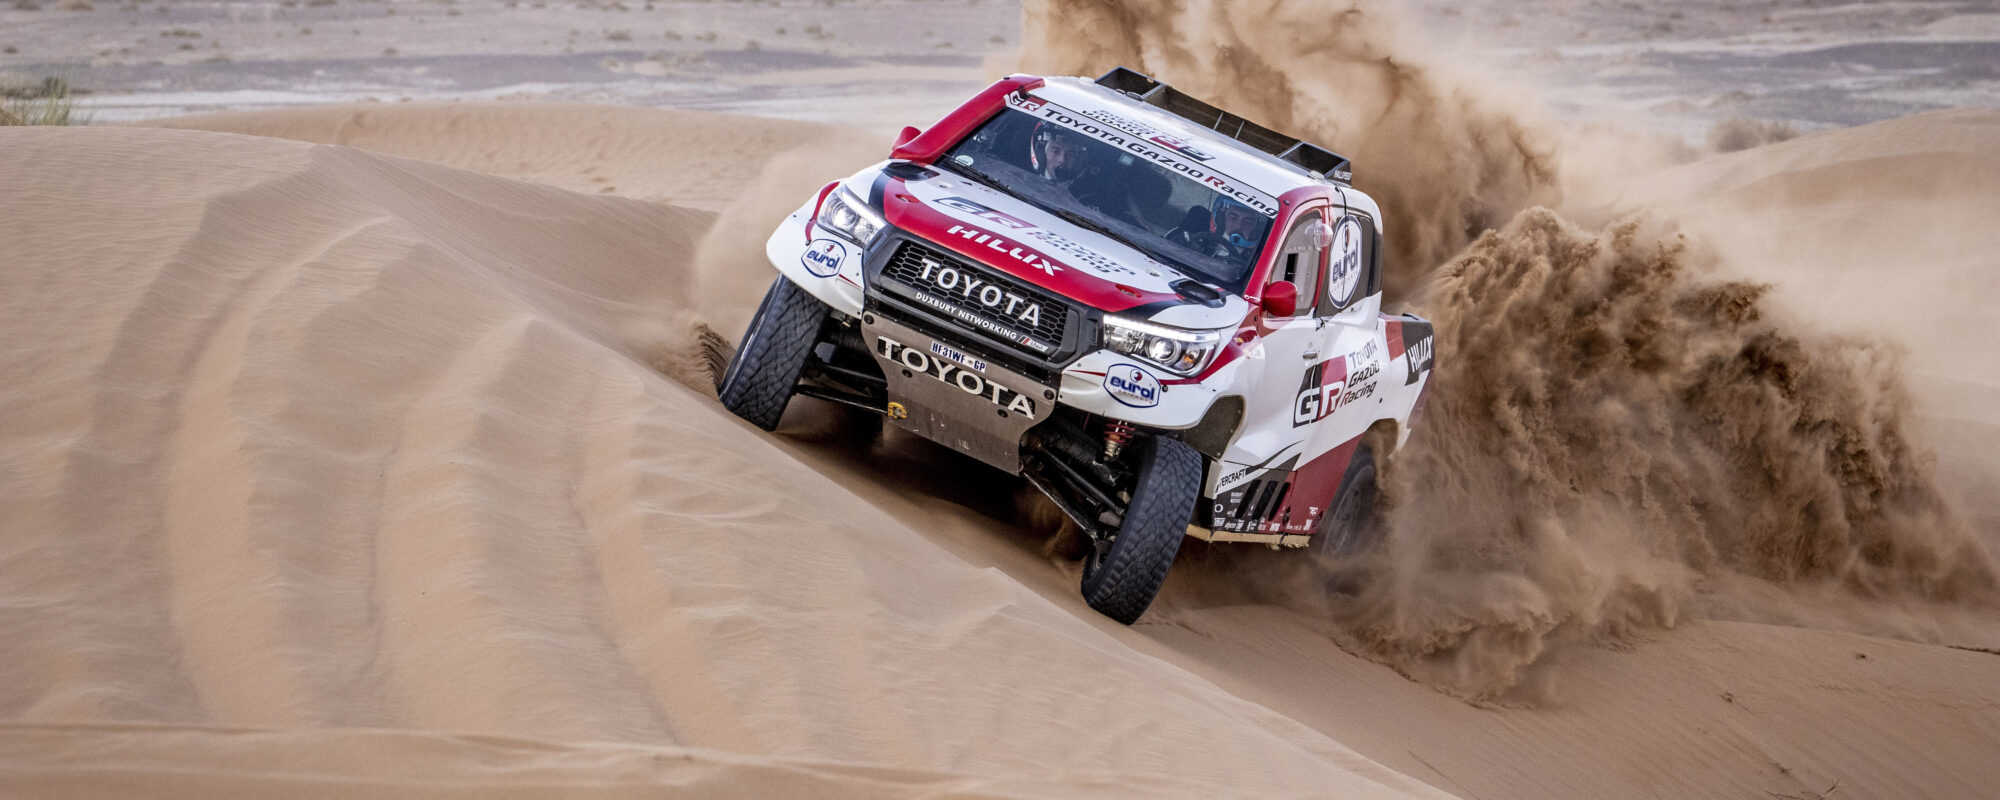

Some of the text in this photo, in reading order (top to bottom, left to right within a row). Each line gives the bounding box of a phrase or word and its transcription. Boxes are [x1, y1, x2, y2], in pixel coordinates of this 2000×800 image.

[1009, 90, 1041, 111] GR
[1044, 108, 1125, 146] TOYOTA
[1126, 141, 1204, 179] GAZOO
[1204, 175, 1279, 217] Racing
[934, 197, 1038, 230] GR
[806, 250, 841, 269] eurol
[946, 225, 1064, 276] HILUX
[1332, 239, 1359, 284] eurol
[919, 258, 1040, 327] TOYOTA
[915, 291, 1017, 340] DUXBURY NETWORKING
[932, 342, 986, 372] HF31WF GP
[1348, 339, 1378, 369] TOYOTA
[1407, 334, 1433, 373] HILUX
[878, 335, 1035, 420] TOYOTA
[1109, 376, 1155, 400] eurol
[1348, 360, 1380, 388] GAZOO
[1293, 379, 1346, 427] GR
[1340, 380, 1378, 408] Racing
